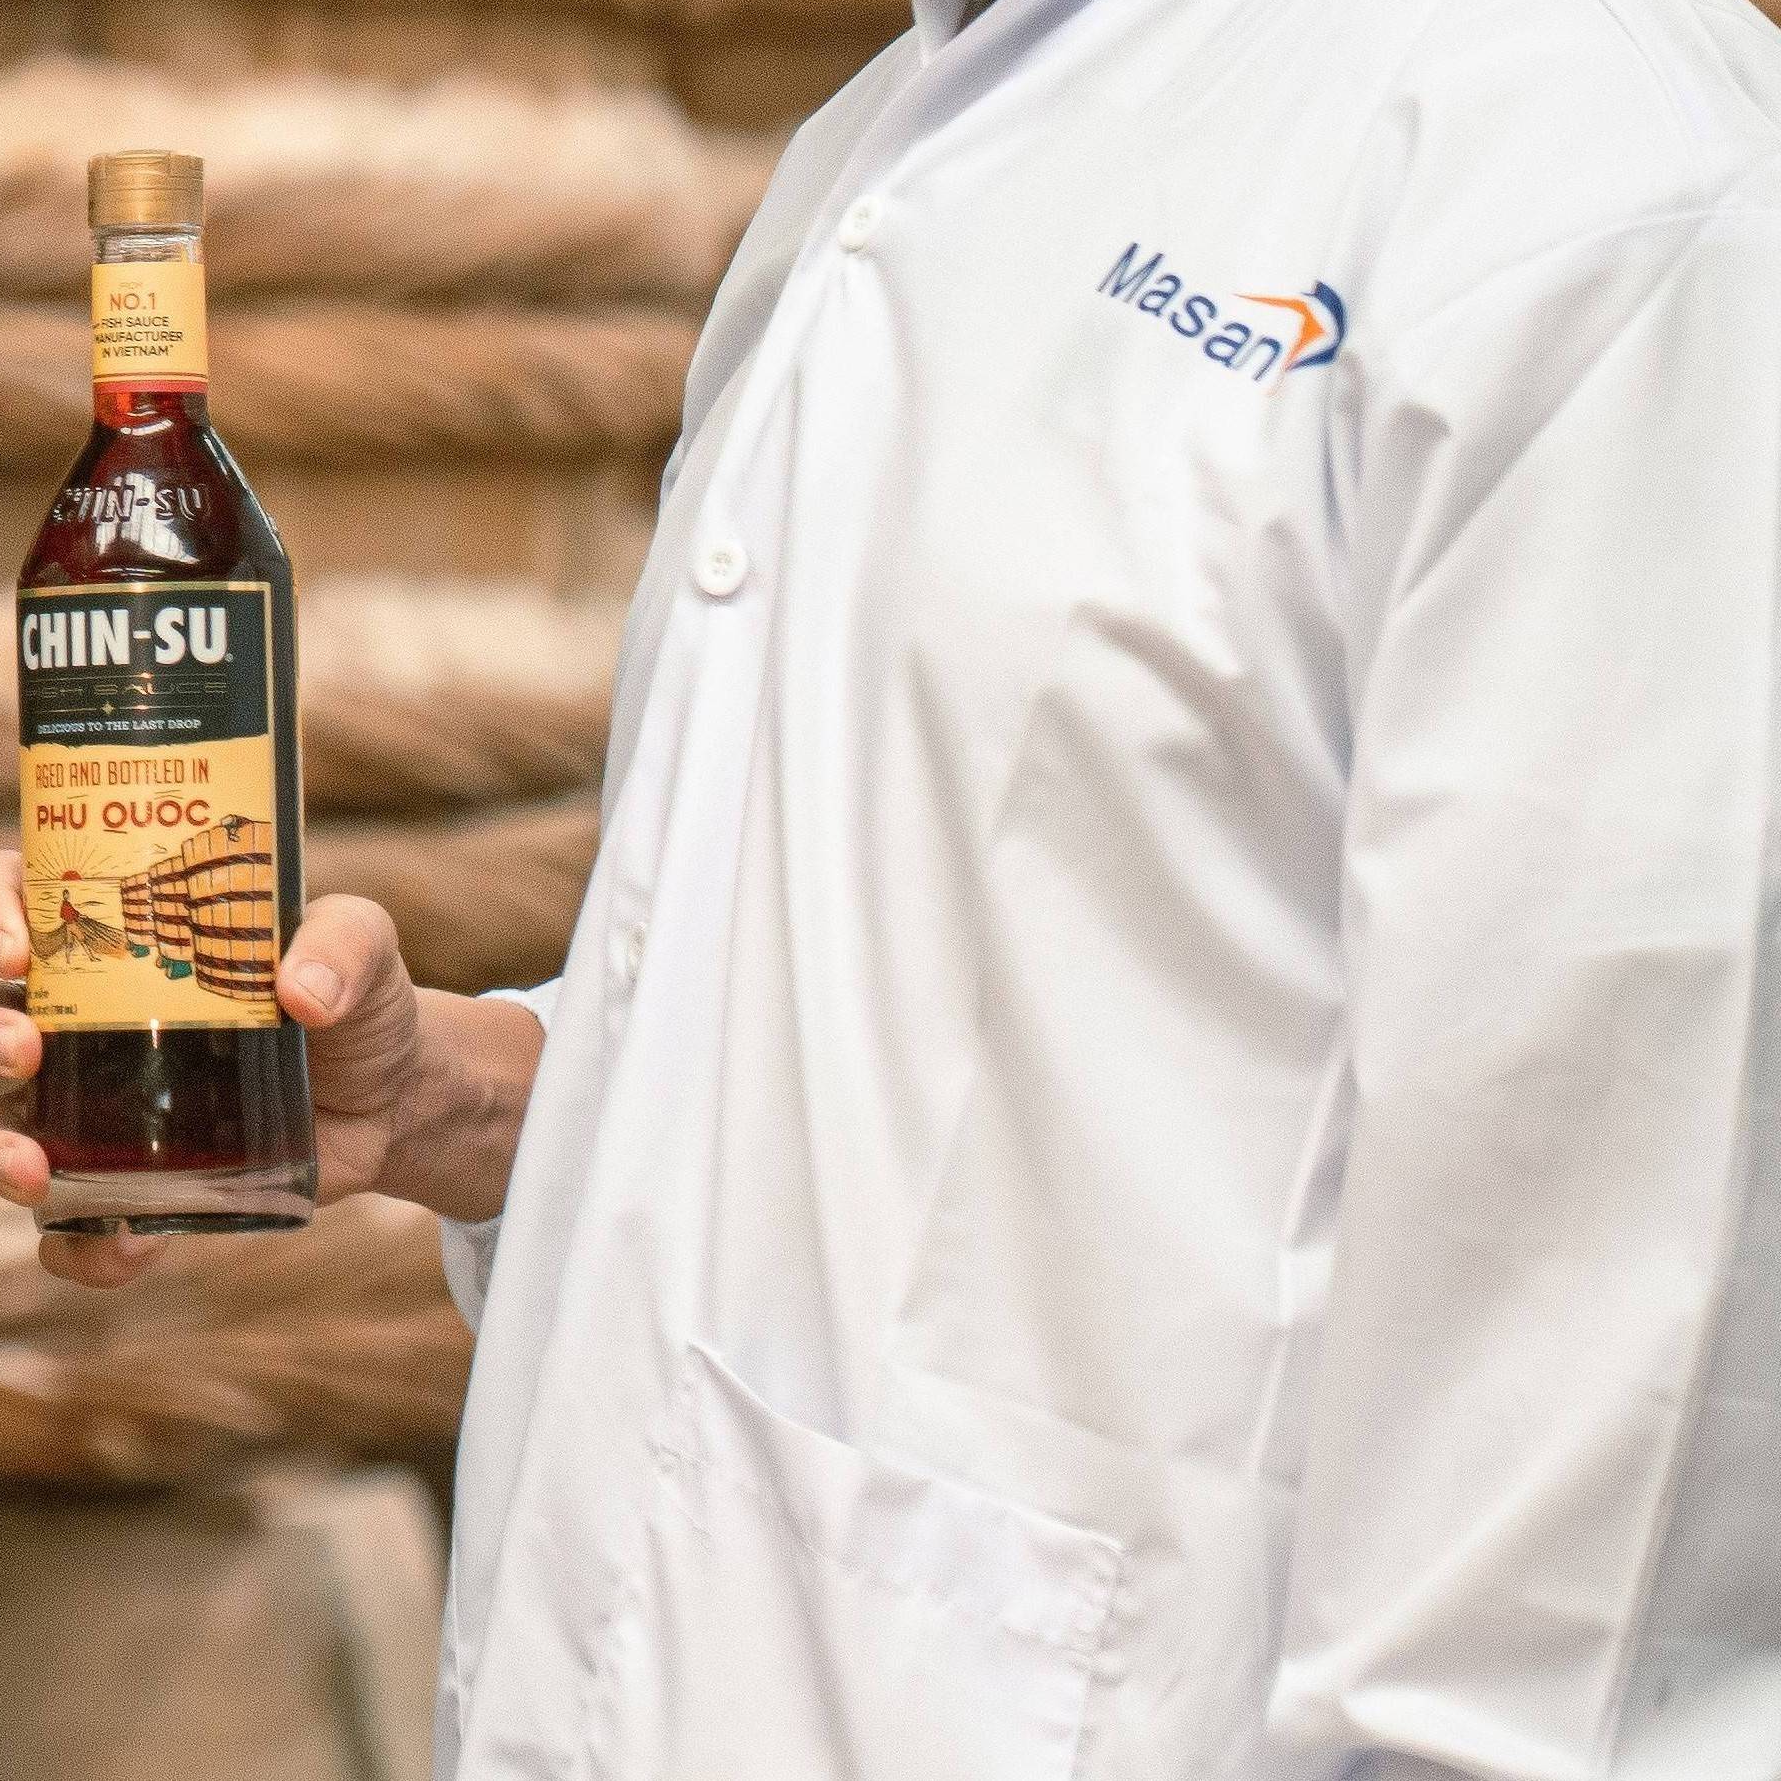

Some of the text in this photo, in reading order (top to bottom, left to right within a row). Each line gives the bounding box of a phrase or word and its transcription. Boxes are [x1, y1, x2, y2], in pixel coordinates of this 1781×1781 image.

[110, 292, 156, 311] NO.1
[126, 316, 169, 327] SAUCE
[1096, 242, 1282, 382] Masan
[95, 331, 183, 343] MANUFACTURER
[23, 606, 227, 670] CHIN-SU
[87, 722, 104, 733] TO
[106, 720, 130, 732] THE
[132, 719, 165, 731] LAST
[168, 718, 202, 730] DROP
[69, 761, 101, 787] AND
[108, 758, 184, 785] BOTTLED
[192, 757, 209, 783] IN
